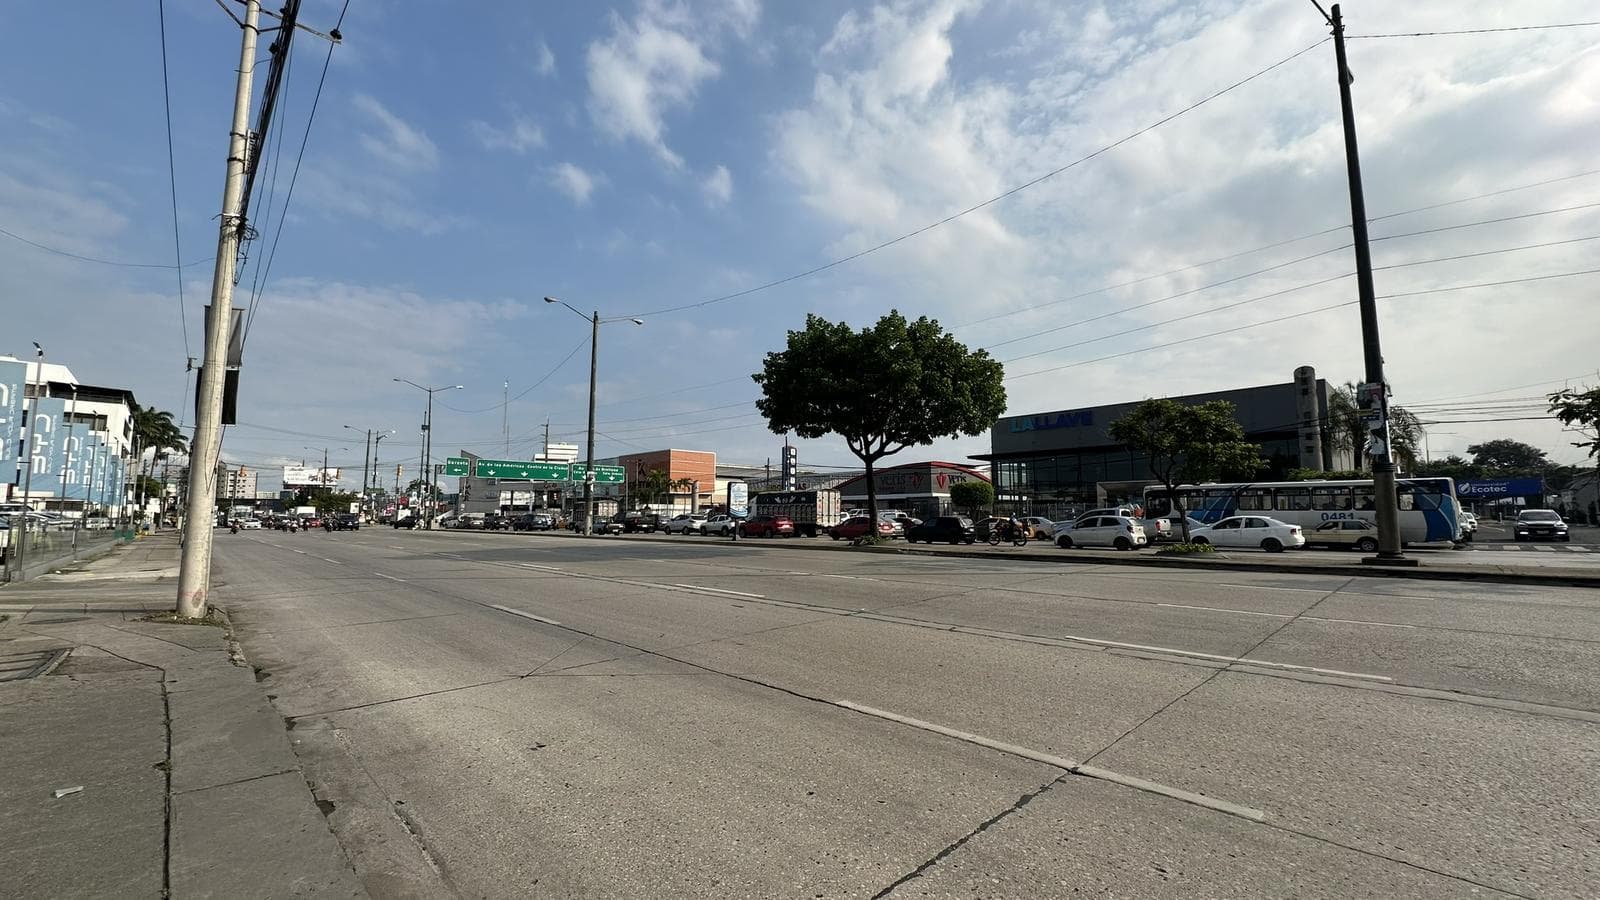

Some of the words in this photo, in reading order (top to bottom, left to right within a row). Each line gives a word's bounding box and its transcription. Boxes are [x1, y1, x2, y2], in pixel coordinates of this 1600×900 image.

[7, 416, 15, 437] YOUR
[31, 413, 51, 474] BYD
[59, 436, 79, 484] BYD
[1471, 486, 1508, 494] Ecotec
[1321, 512, 1354, 521] 0481
